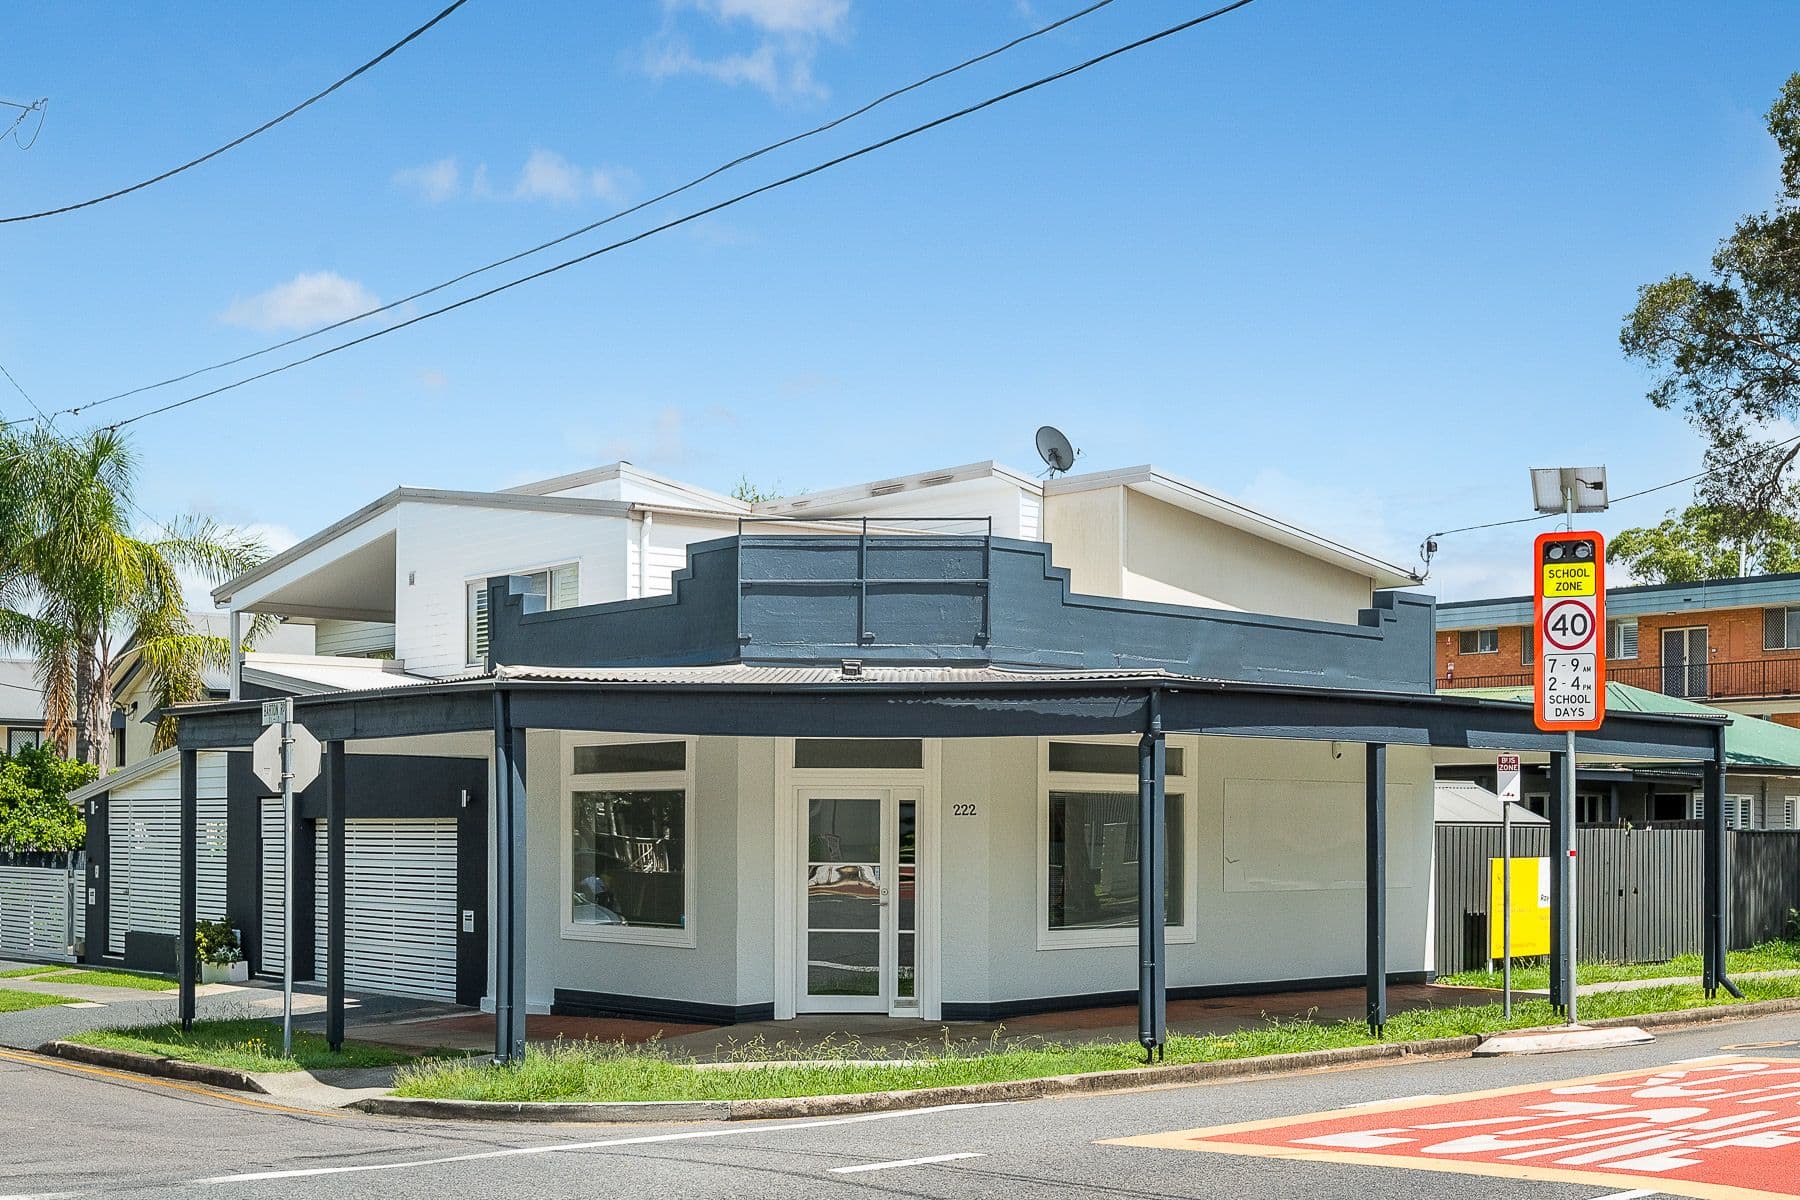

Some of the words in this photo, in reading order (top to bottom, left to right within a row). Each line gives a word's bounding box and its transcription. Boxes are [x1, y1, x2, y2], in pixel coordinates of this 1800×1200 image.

[1548, 568, 1590, 579] SCHOOL
[1555, 581, 1583, 592] ZONE
[1551, 613, 1588, 637] 40
[1548, 658, 1557, 673] 7
[1570, 657, 1580, 672] 9
[1548, 676, 1558, 691] 2
[1570, 675, 1581, 691] 4
[1548, 694, 1591, 705] SCHOOL
[1555, 707, 1585, 717] DAYS
[953, 803, 977, 816] 222
